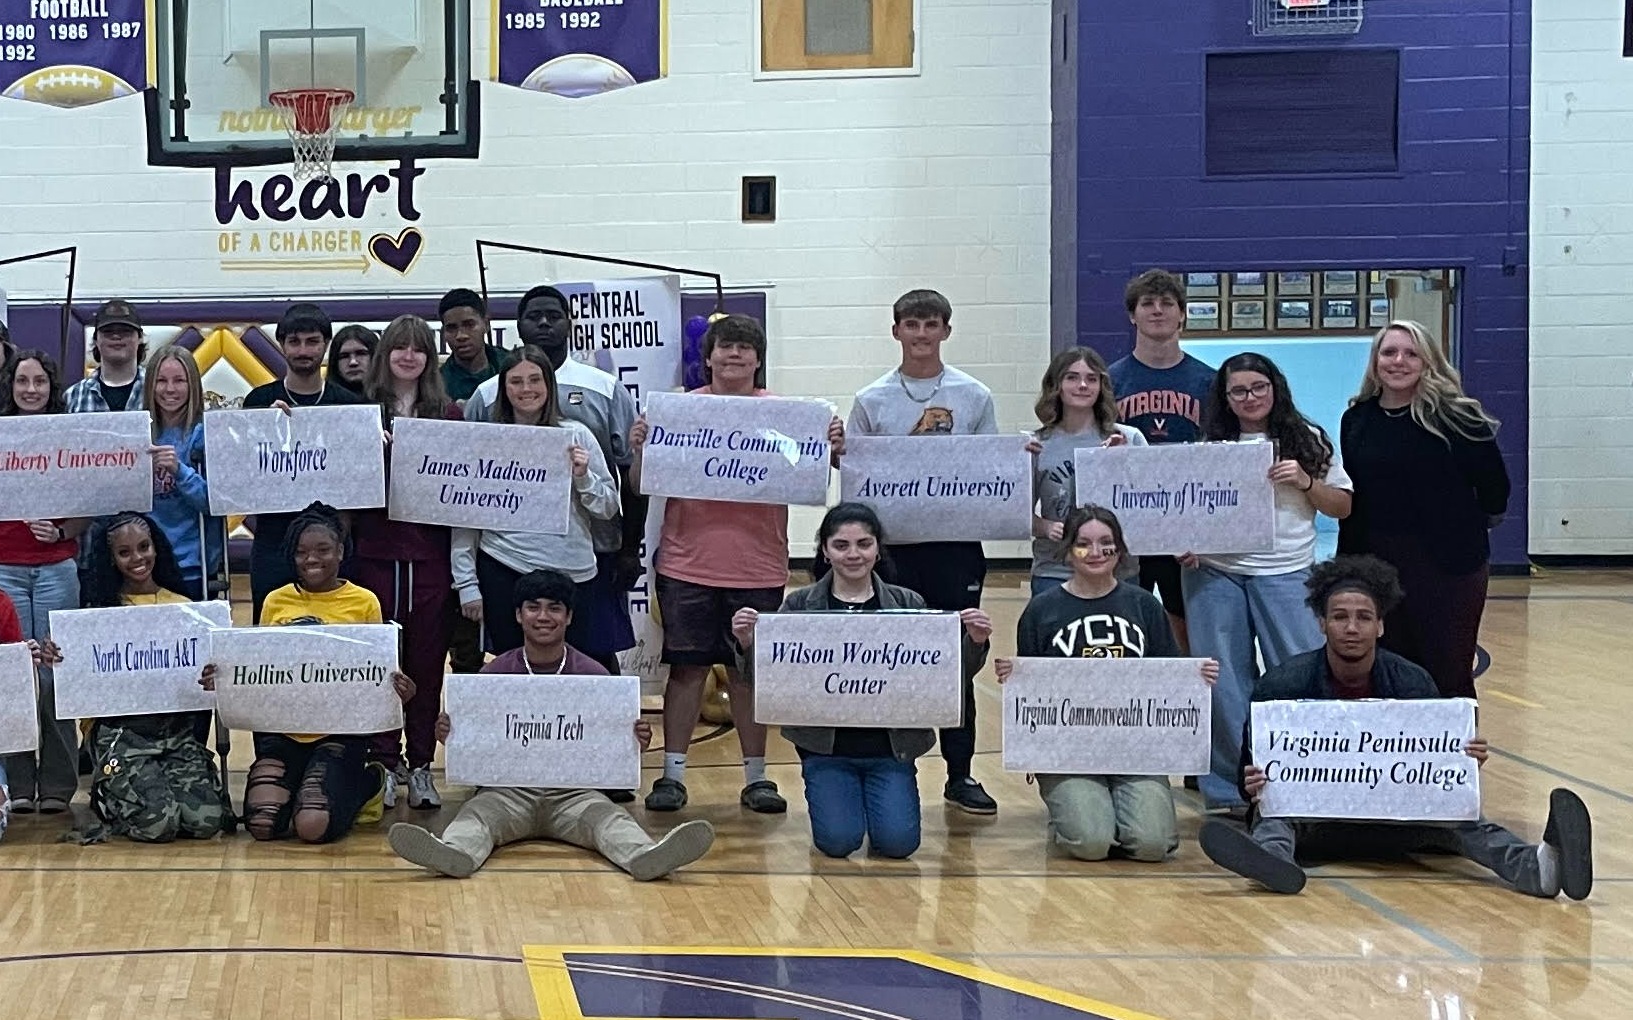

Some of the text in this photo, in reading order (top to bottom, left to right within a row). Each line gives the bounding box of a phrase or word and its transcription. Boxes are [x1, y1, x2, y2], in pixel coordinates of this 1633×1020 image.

[30, 0, 109, 19] FOOTBALL
[505, 12, 601, 30] 1985 1992
[49, 23, 88, 40] 1986
[102, 22, 141, 39] 1987
[338, 106, 423, 136] arger
[215, 159, 426, 225] heart
[218, 230, 362, 253] OF A CHARGER
[569, 290, 645, 320] CENTRAL
[569, 320, 664, 352] IGH SCHOOL
[1117, 389, 1200, 427] VIRGINIA
[57, 446, 138, 470] University
[650, 425, 828, 461] Danville Commnity
[257, 440, 327, 481] Workforce
[417, 454, 547, 482] James Madison
[704, 456, 768, 485] College
[439, 484, 524, 514] University
[857, 475, 1016, 501] Averett University
[1112, 481, 1238, 516] University of Virginia
[1052, 614, 1145, 659] VCU
[92, 637, 198, 673] North Carolina A&T
[771, 642, 941, 671] Wilson Workforce
[232, 660, 387, 687] Hollins University
[824, 672, 887, 695] Center
[505, 713, 584, 747] Virginia Tech
[1015, 697, 1200, 735] Virginia Commonwealth University
[1268, 730, 1461, 758] Virginia Peninsula
[1264, 759, 1467, 791] Community College
